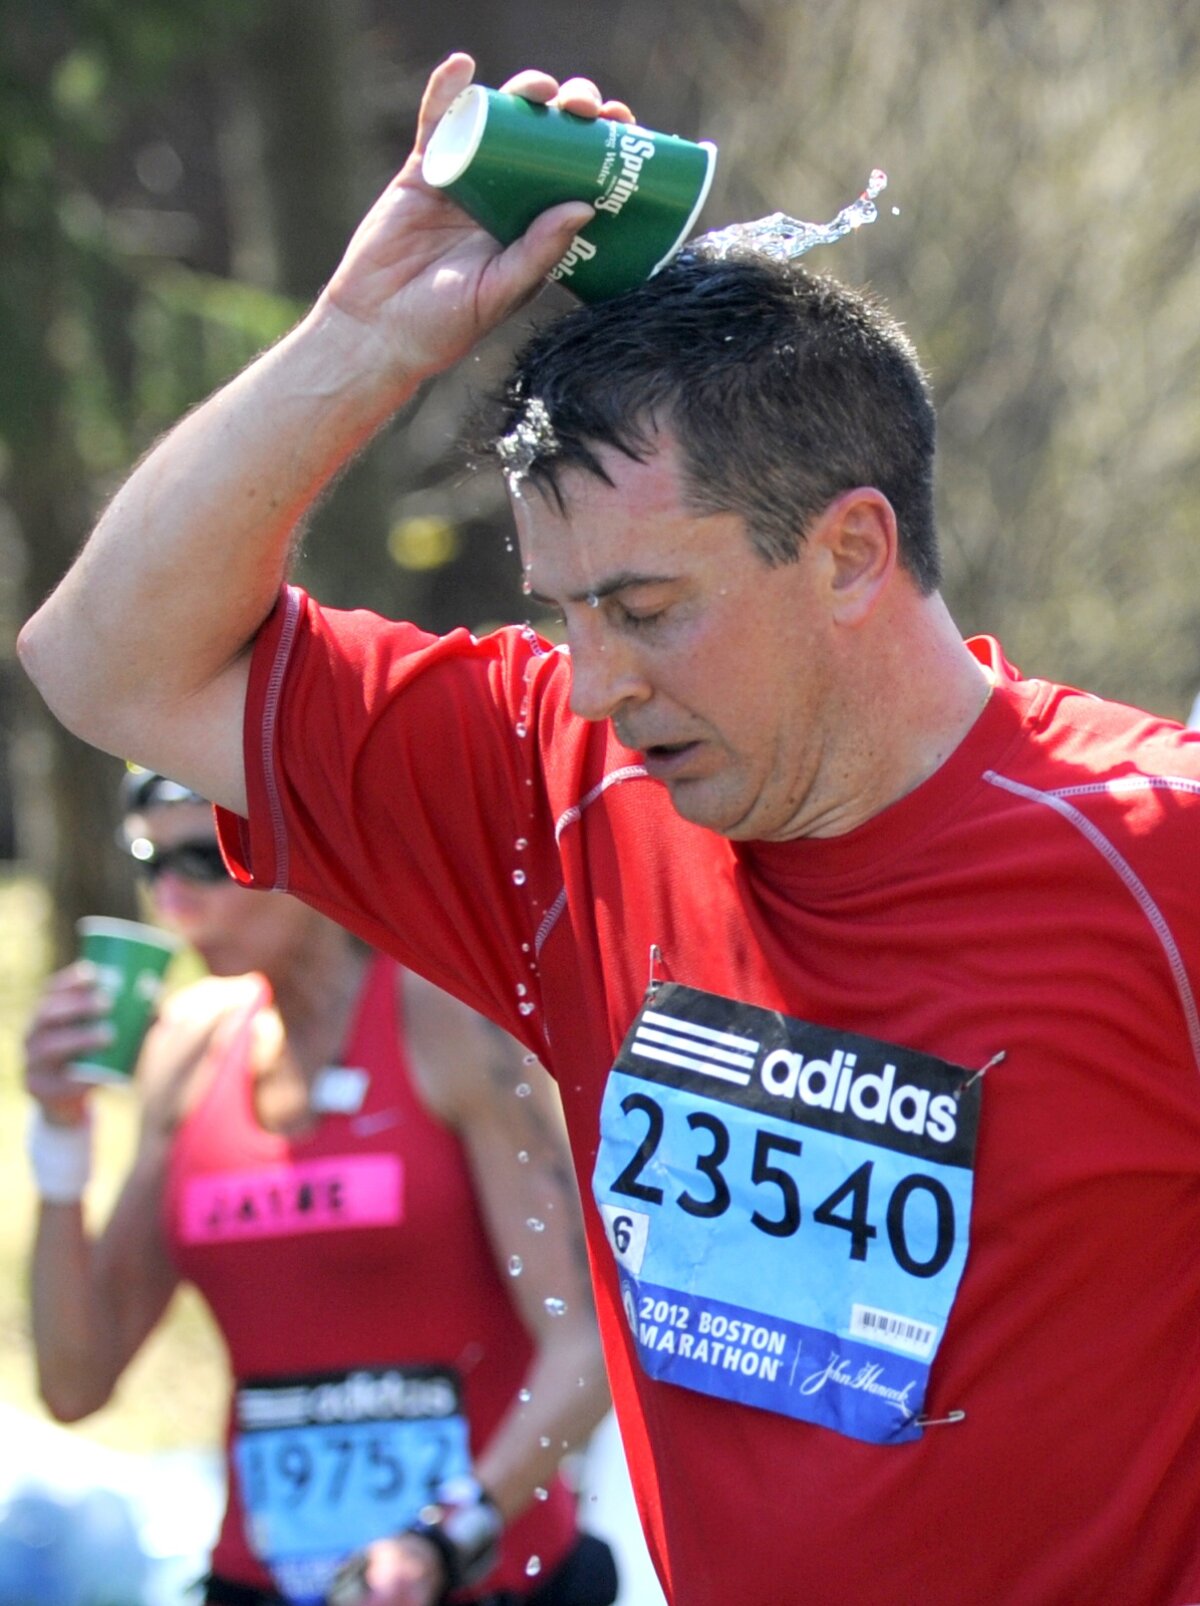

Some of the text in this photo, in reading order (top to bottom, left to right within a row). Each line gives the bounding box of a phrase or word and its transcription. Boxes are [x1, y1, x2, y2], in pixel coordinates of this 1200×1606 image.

[594, 134, 656, 216] Spring
[596, 152, 617, 187] Water
[549, 234, 598, 281] Pola
[761, 1048, 958, 1144] adidas
[609, 1093, 956, 1279] 23540
[613, 1215, 634, 1254] 6
[639, 1296, 787, 1356] 2012 BOSTON
[639, 1322, 779, 1382] MARATHON
